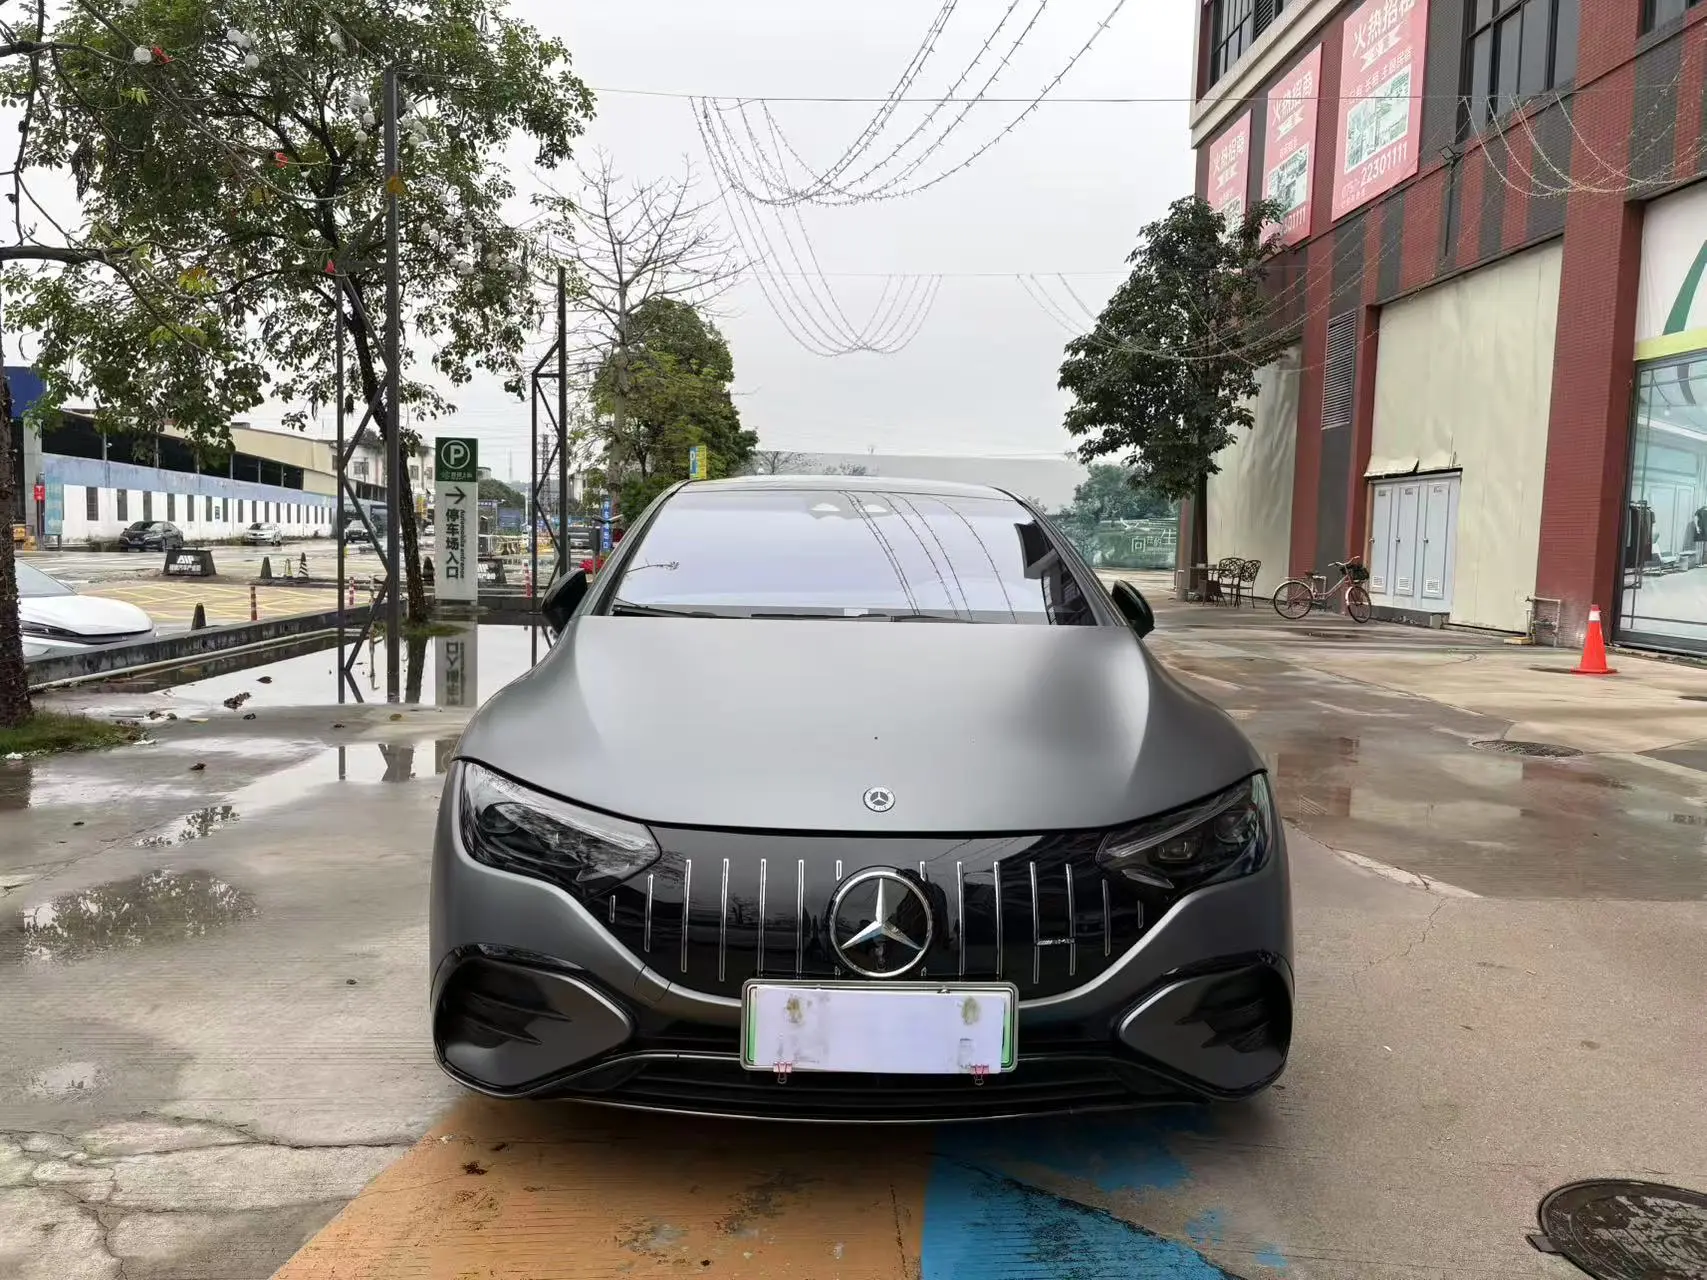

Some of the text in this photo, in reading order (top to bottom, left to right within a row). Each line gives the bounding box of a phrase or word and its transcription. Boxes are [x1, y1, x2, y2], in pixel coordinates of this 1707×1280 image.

[1360, 141, 1408, 188] 22301111
[450, 445, 465, 465] P
[445, 508, 459, 579] 停车场入口
